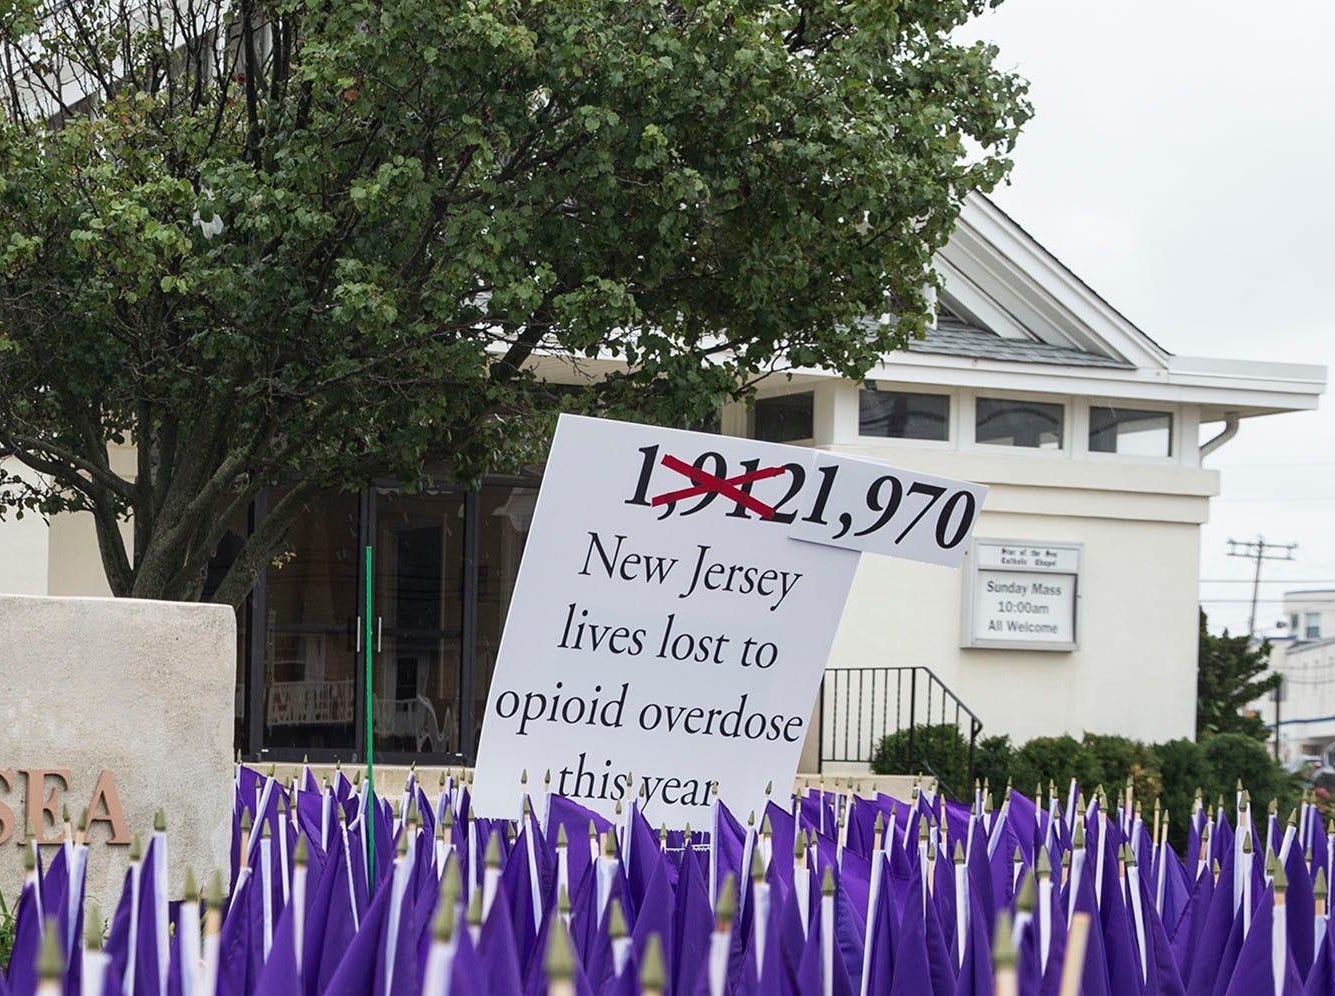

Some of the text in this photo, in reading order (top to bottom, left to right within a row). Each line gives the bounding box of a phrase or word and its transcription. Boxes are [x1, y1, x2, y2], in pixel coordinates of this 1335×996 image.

[801, 465, 977, 550] 1,970
[578, 531, 803, 611] New Jersey
[986, 580, 1062, 596] Sunday Mass
[557, 603, 778, 669] lives lost to
[988, 620, 1059, 634] All Welcome
[998, 601, 1049, 614] 10:00am
[495, 682, 803, 742] opioid overdose
[558, 752, 719, 815] this year
